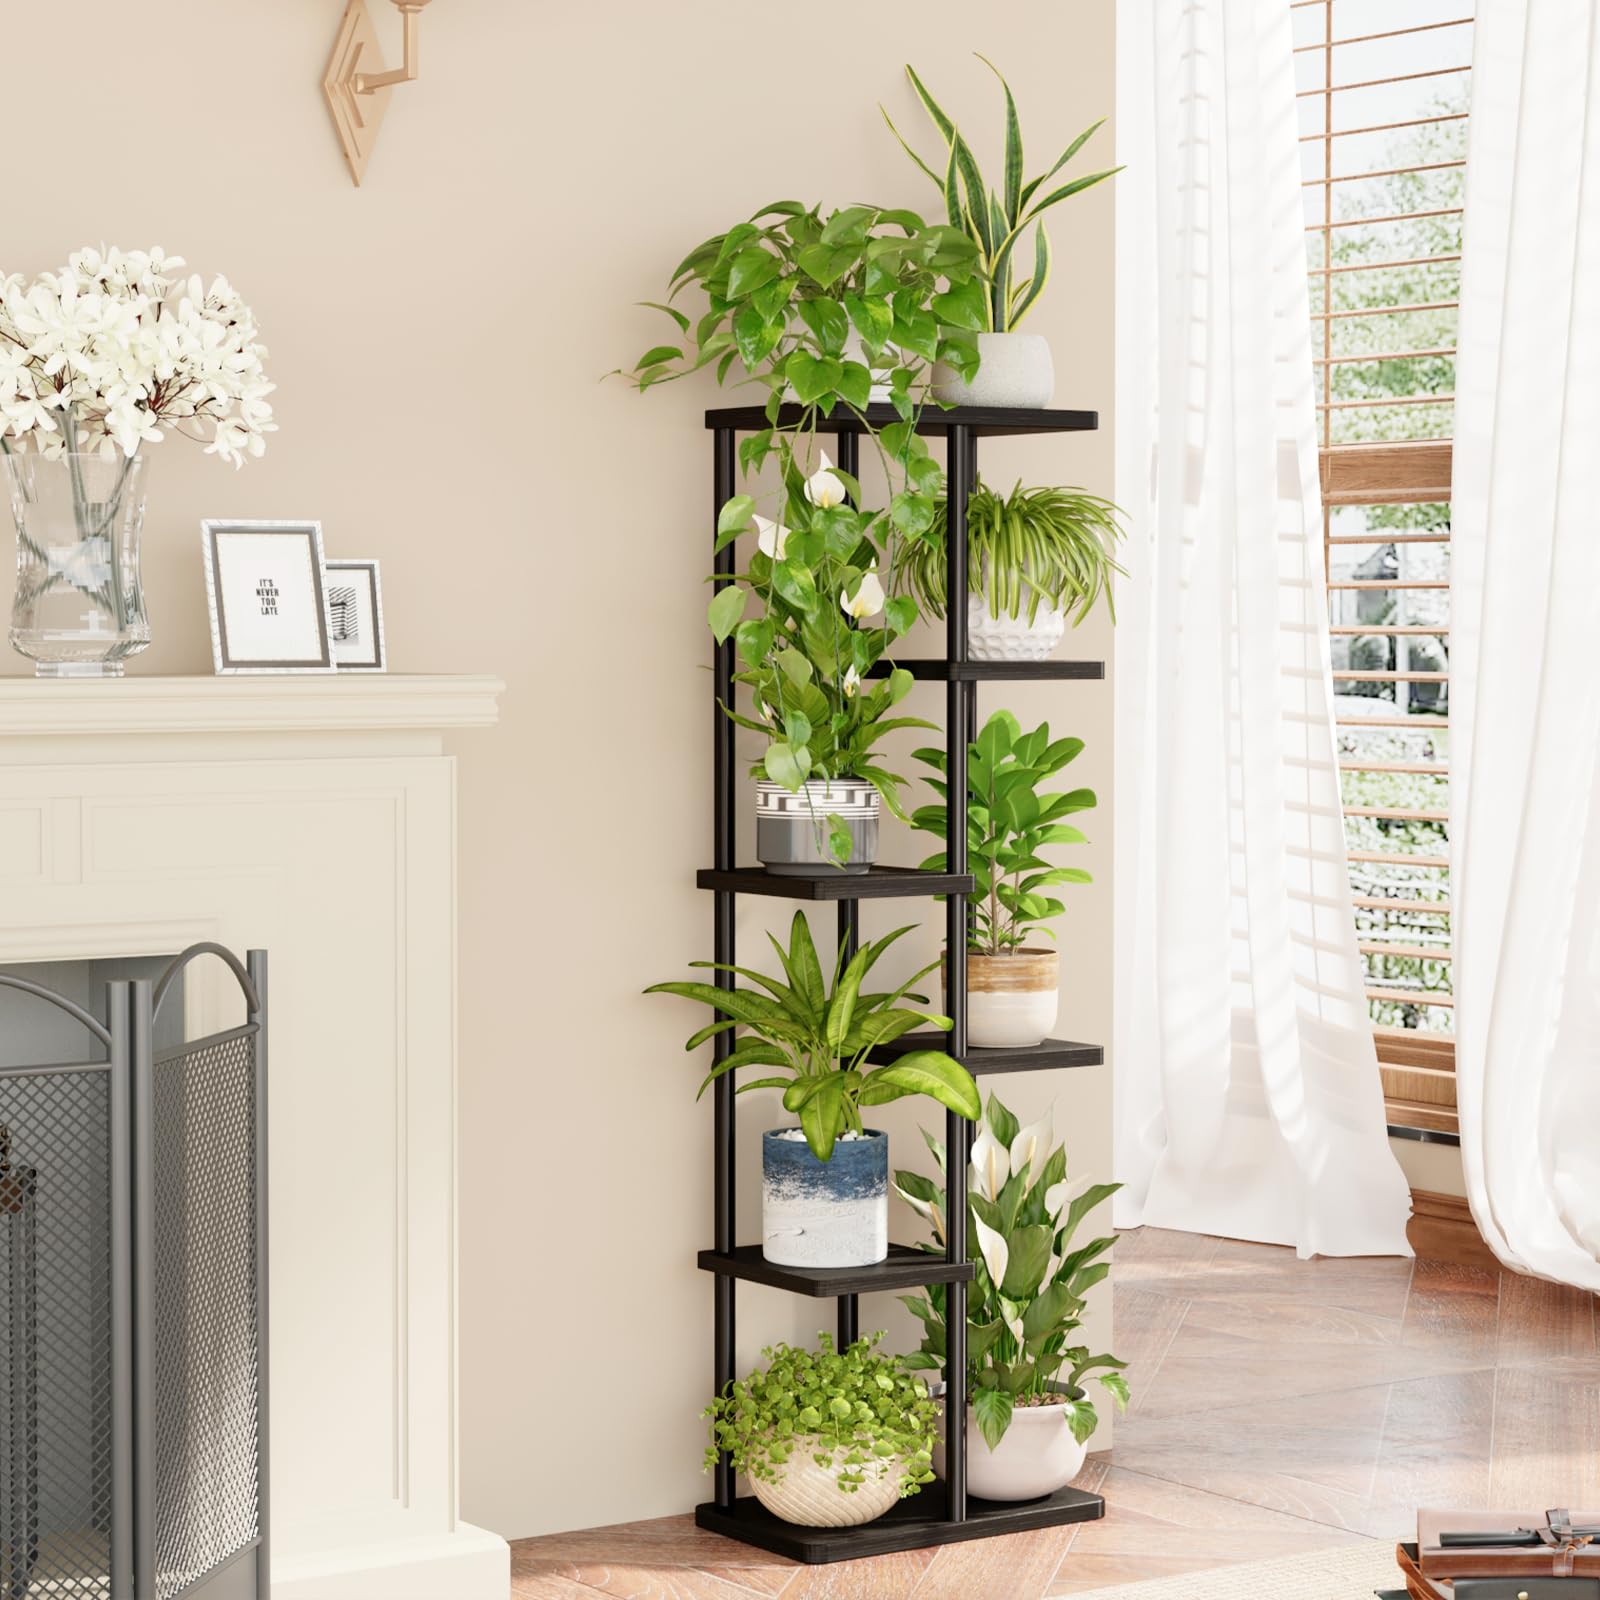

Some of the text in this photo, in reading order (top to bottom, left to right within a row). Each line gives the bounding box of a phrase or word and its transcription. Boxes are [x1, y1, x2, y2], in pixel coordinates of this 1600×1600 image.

[259, 579, 274, 587] IT'S
[256, 588, 279, 597] NEVER
[261, 597, 276, 606] TOO
[261, 607, 279, 615] LATE
